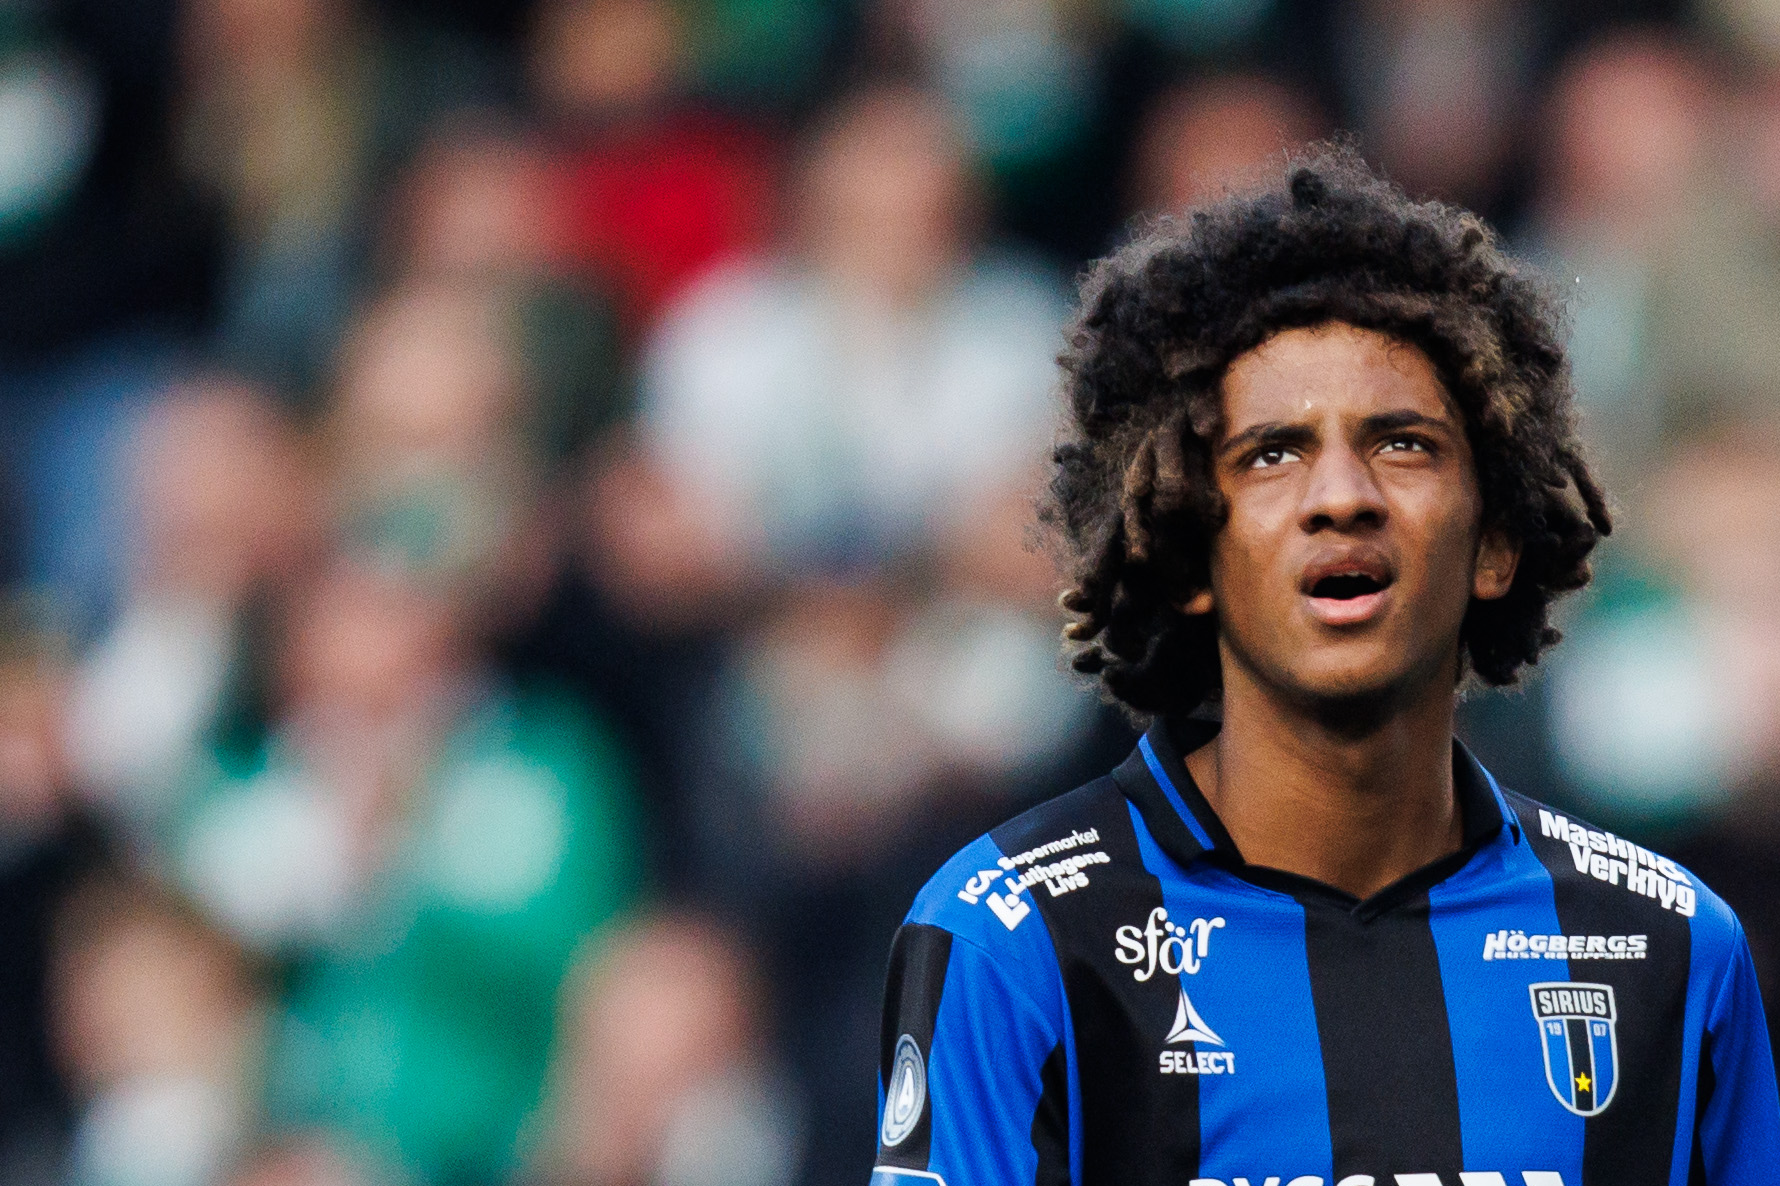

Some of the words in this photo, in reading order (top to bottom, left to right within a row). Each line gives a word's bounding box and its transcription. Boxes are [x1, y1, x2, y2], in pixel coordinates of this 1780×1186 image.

[957, 869, 1004, 905] ICA
[997, 827, 1100, 871] Supermarket
[1004, 851, 1111, 895] Luthagens
[1568, 842, 1696, 917] Verktyg
[1044, 871, 1090, 897] Livs
[1115, 906, 1226, 982] sfär
[1483, 930, 1648, 961] HÖGBERGS
[1538, 990, 1607, 1015] SIRIUS
[1546, 1022, 1562, 1037] 19
[1593, 1023, 1607, 1037] 07
[1159, 1051, 1236, 1075] SELECT
